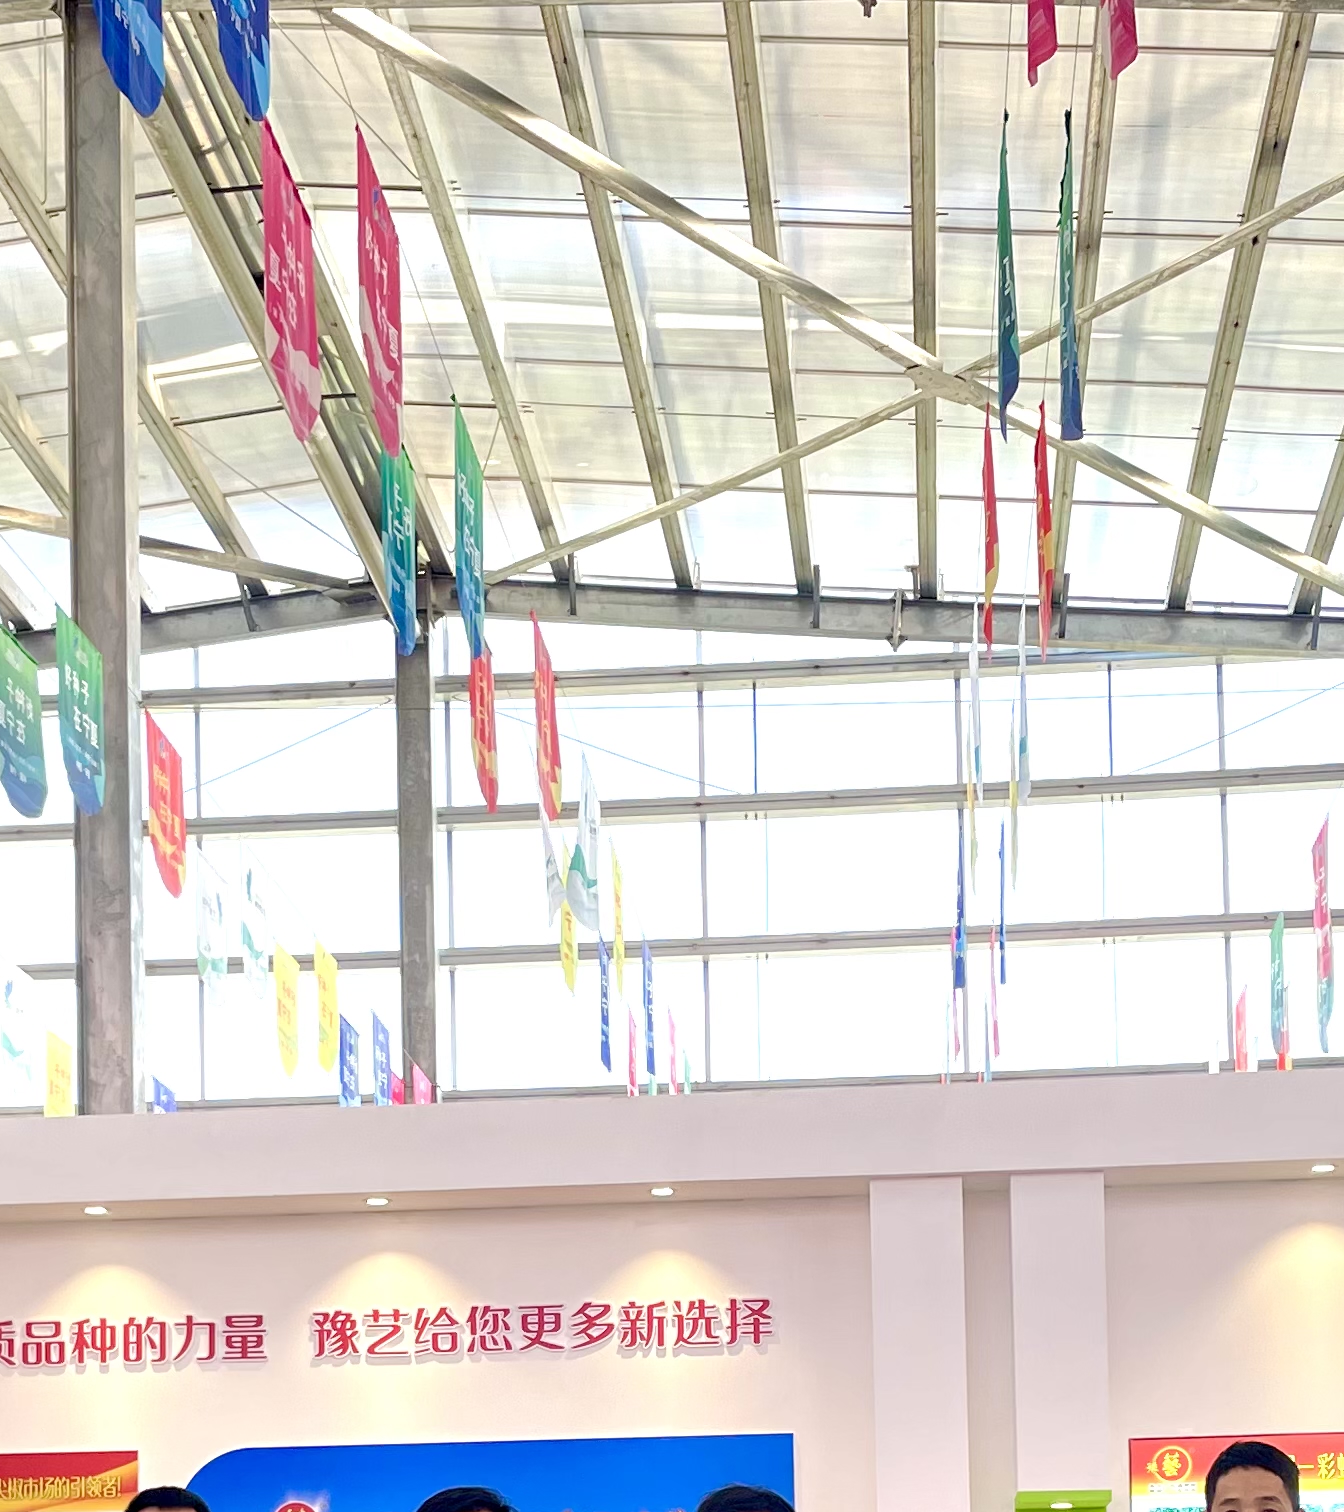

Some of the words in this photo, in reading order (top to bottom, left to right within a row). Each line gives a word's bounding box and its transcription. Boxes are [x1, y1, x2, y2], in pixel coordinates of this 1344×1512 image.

[312, 1297, 774, 1360] 豫艺给您更多新选择
